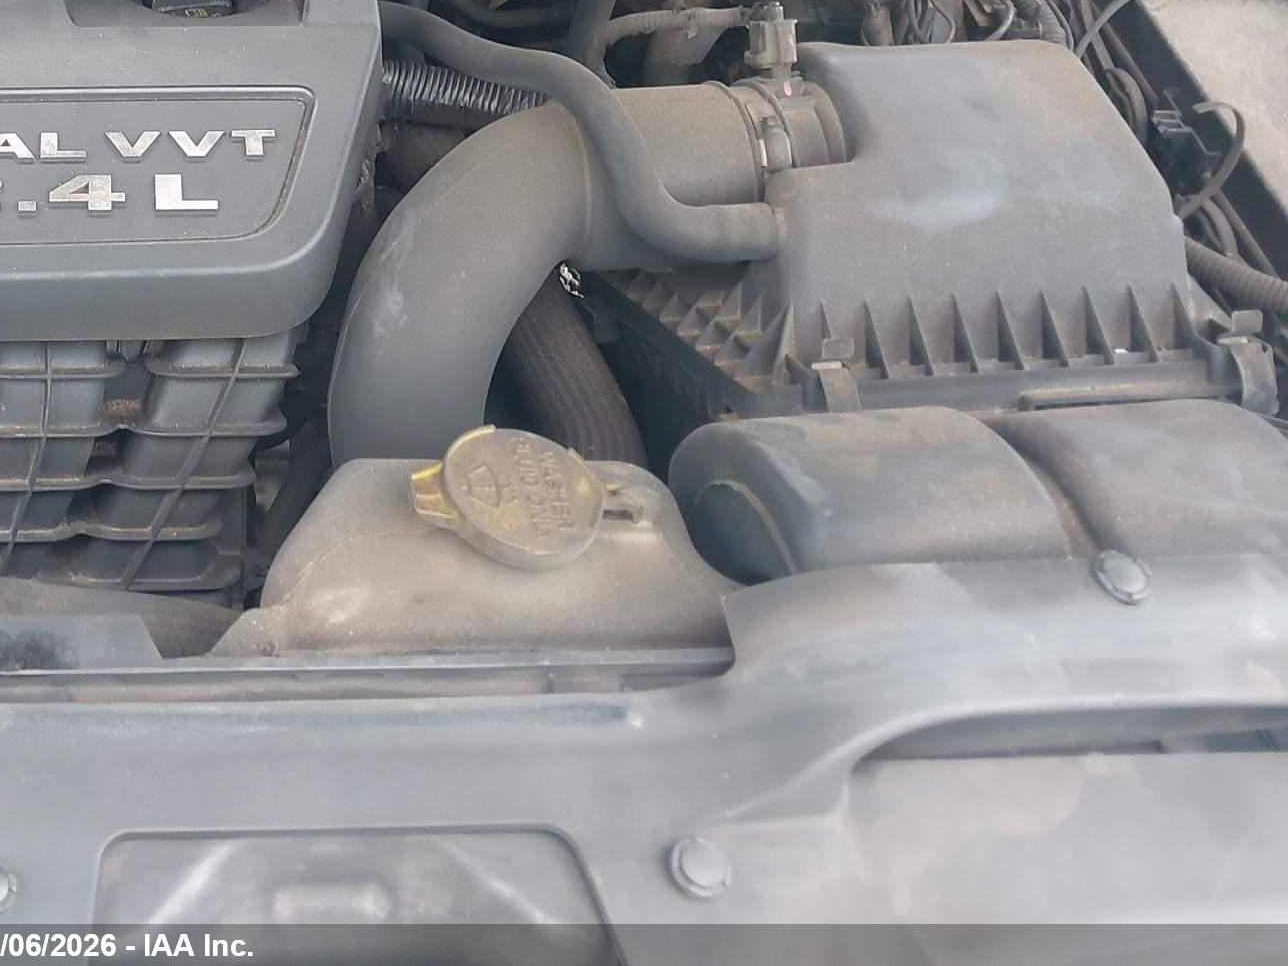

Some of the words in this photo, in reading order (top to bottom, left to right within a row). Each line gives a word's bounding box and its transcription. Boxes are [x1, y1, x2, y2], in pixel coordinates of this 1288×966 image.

[105, 130, 275, 160] VVT
[154, 173, 219, 213] L
[512, 437, 539, 489] FLUID
[526, 493, 554, 539] ONLY
[535, 451, 576, 530] WASHER
